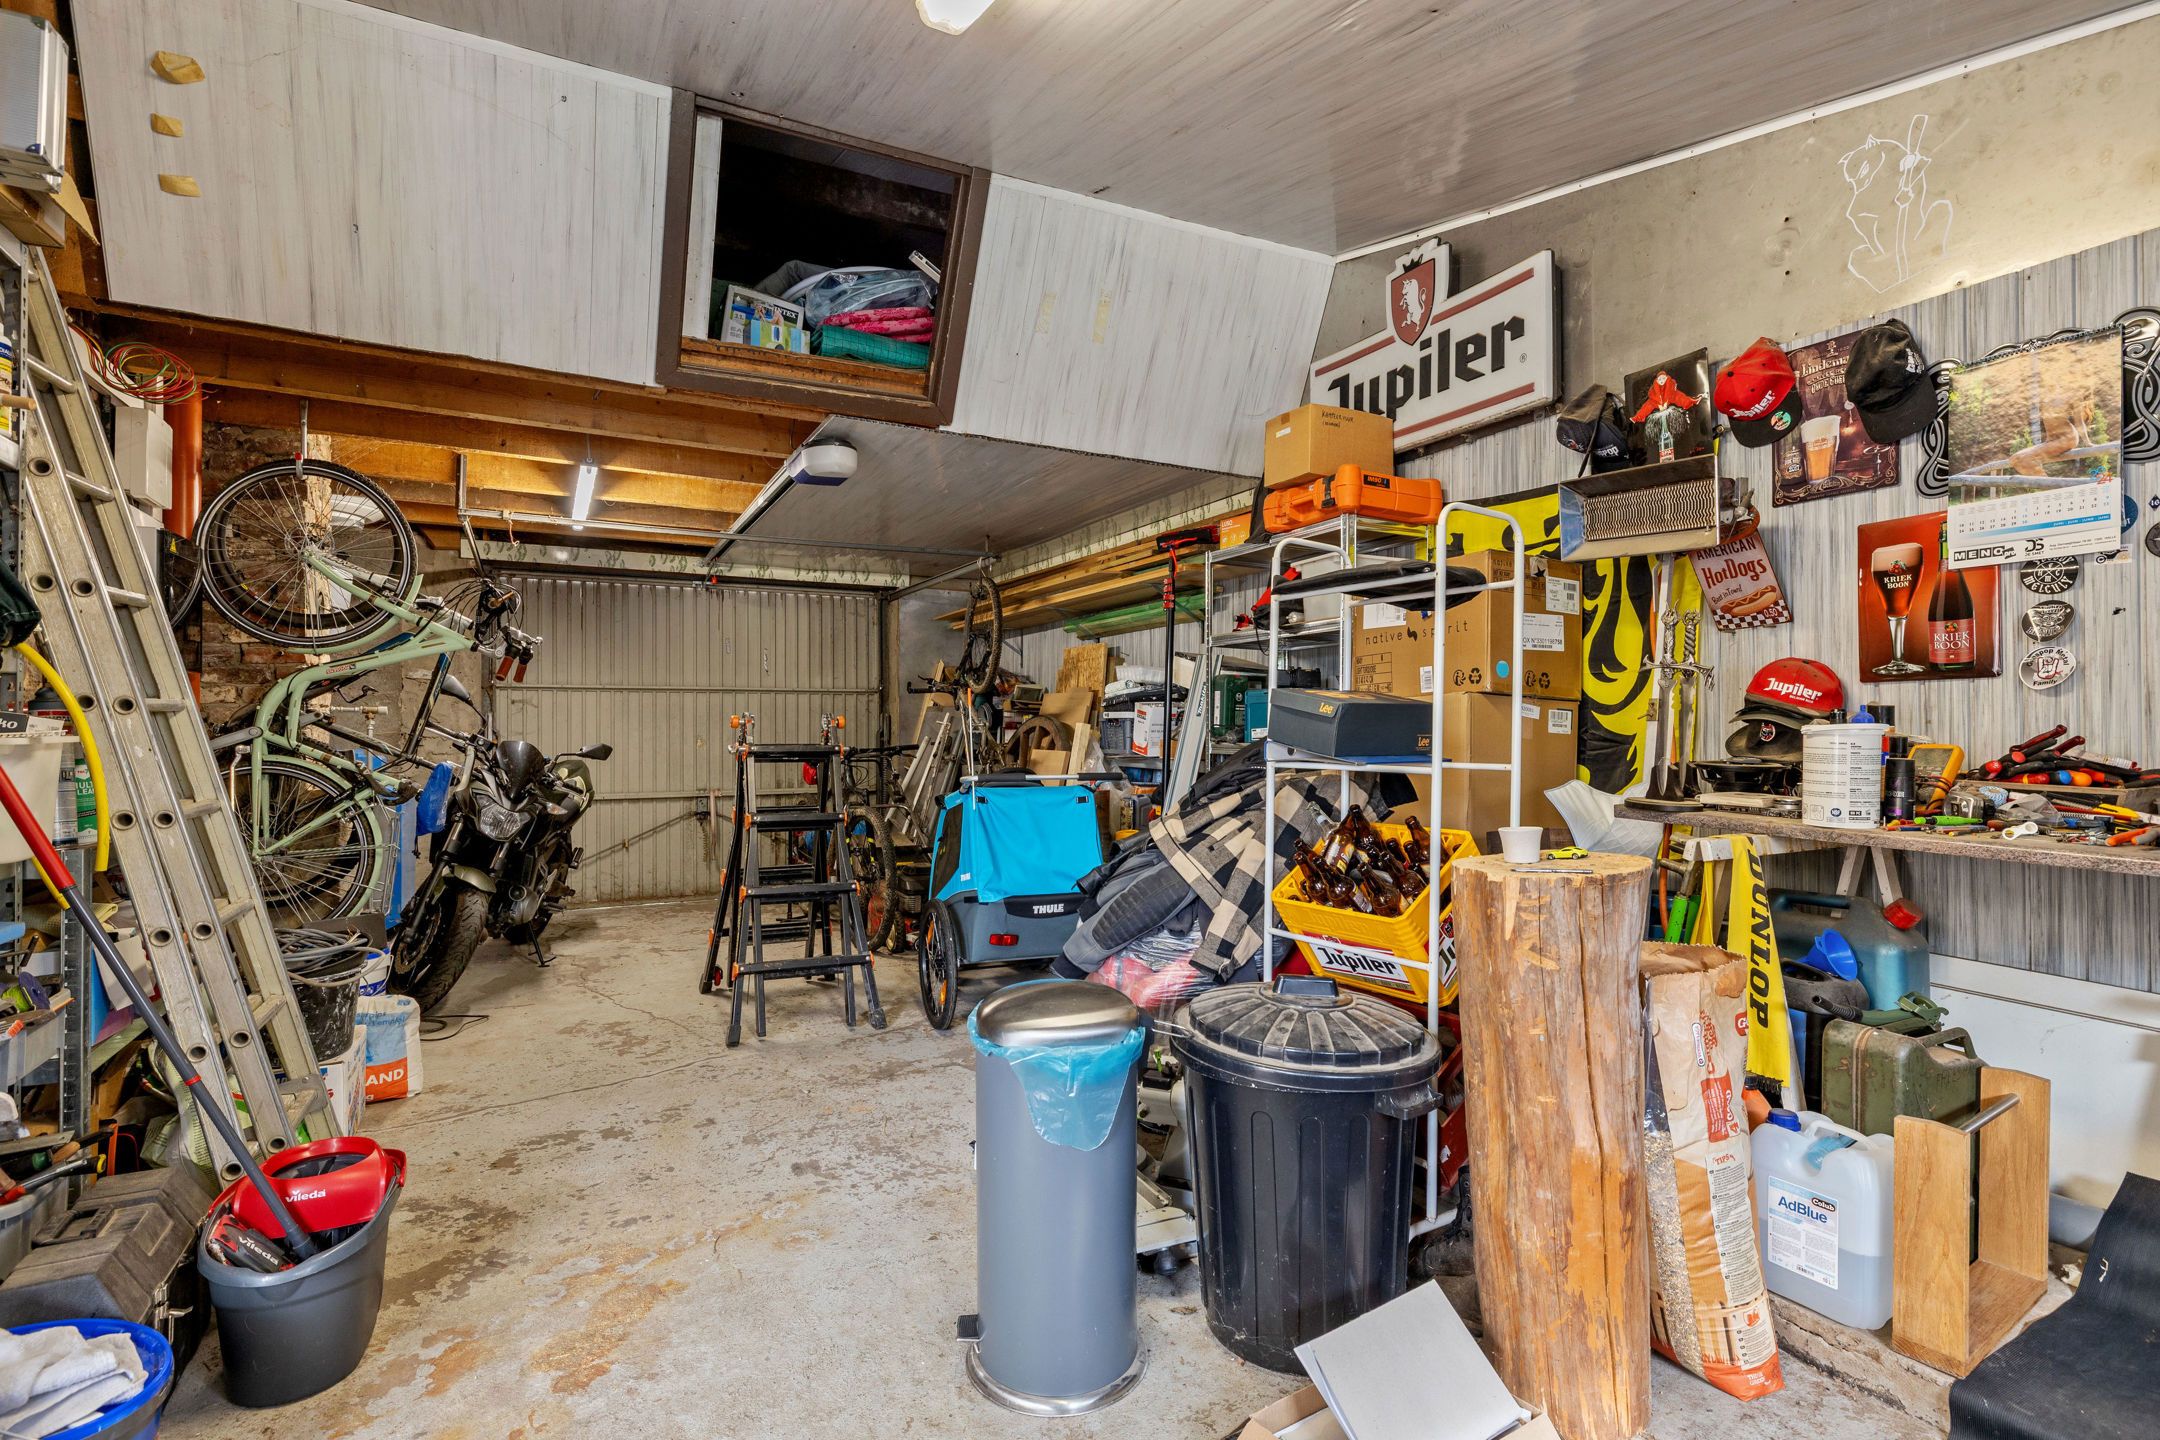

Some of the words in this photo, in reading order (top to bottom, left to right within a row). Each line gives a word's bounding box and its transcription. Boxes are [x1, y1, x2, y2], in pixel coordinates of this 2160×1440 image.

[1327, 315, 1525, 422] Jupiler
[1801, 355, 1849, 377] Lindema
[1697, 537, 1757, 560] AMERICAN
[1884, 574, 1912, 584] KRIEK
[1887, 580, 1910, 589] BOON
[1763, 607, 1779, 618] 0.50
[1365, 631, 1403, 646] native
[1423, 620, 1468, 640] sprit
[1934, 631, 1970, 642] KRIEK
[1934, 639, 1970, 650] BOON
[1763, 677, 1823, 700] Jupiler
[2032, 679, 2058, 687] Family
[1319, 702, 1334, 714] Lee
[1417, 736, 1430, 747] Lee
[1032, 903, 1064, 914] THULE
[1747, 848, 1771, 1029] DUNLOP
[1317, 947, 1397, 975] Jupiler
[285, 1188, 327, 1203] vileda
[1778, 1196, 1828, 1223] AdBlue
[1812, 1198, 1835, 1212] Colub
[238, 1235, 280, 1266] vileda
